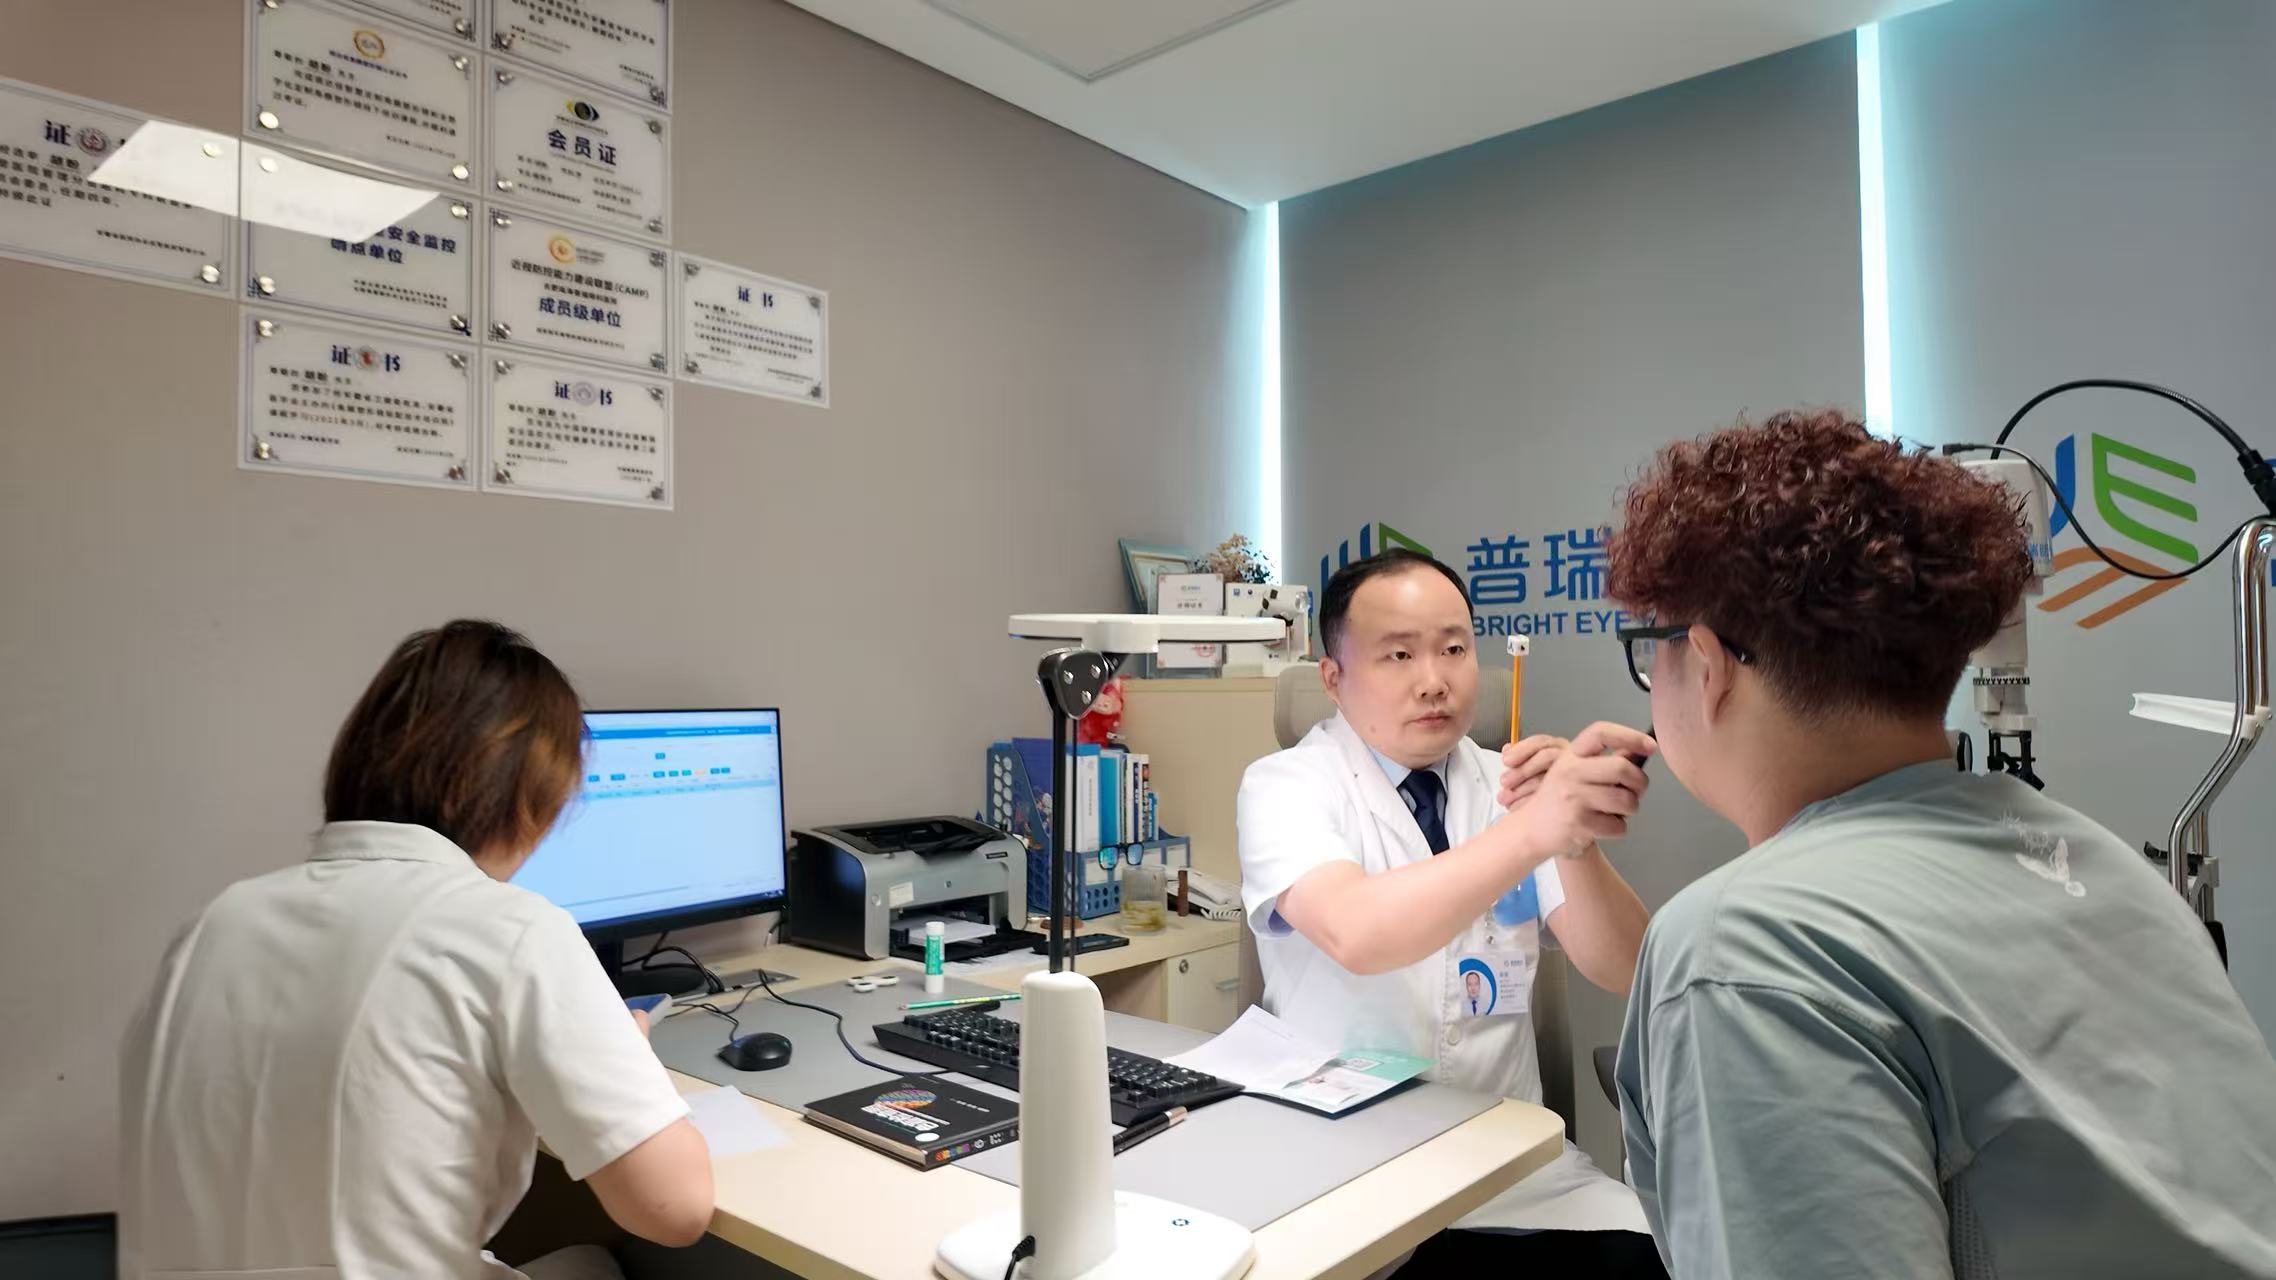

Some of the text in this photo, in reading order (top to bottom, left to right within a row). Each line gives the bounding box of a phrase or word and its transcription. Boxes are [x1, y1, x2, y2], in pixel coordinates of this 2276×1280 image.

[548, 129, 617, 166] 会员证
[539, 297, 622, 328] 成员级单位
[1466, 527, 1613, 605] 普瑞
[1471, 612, 1569, 637] BRIGHT
